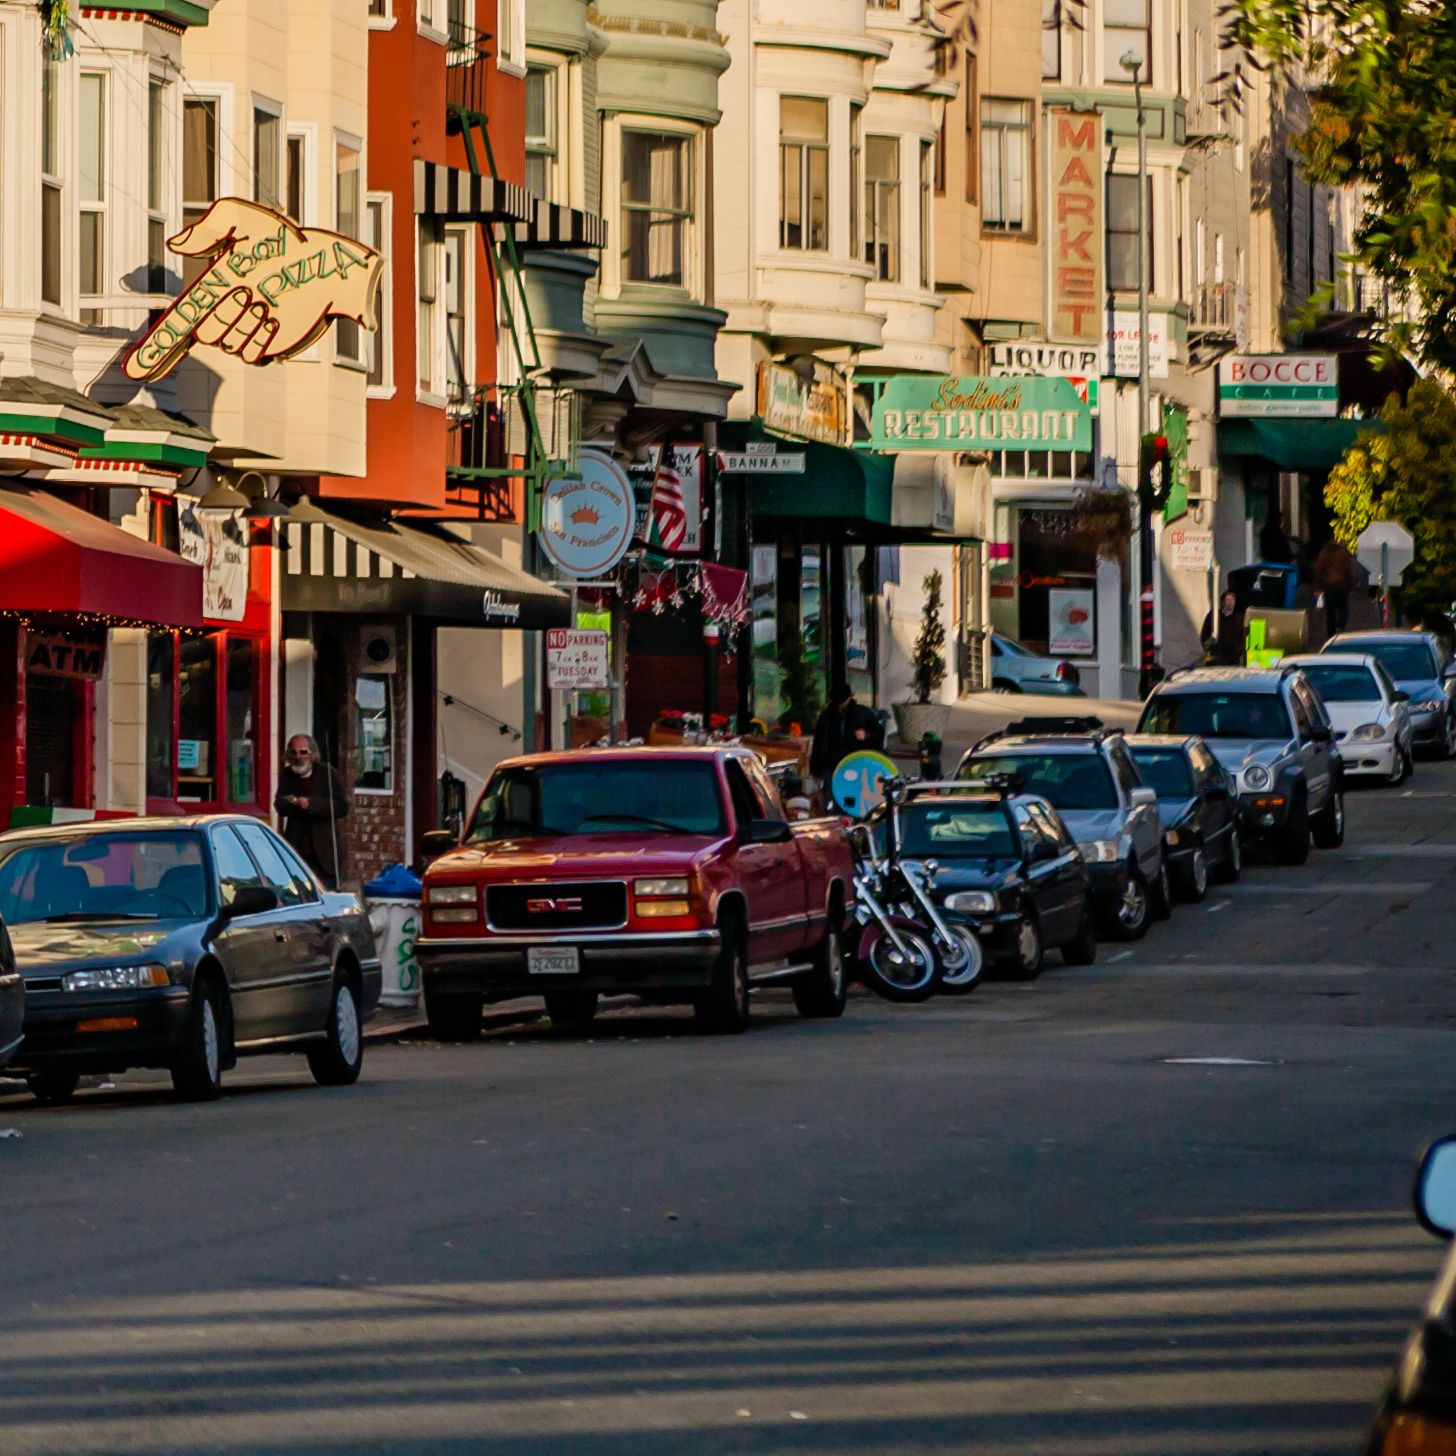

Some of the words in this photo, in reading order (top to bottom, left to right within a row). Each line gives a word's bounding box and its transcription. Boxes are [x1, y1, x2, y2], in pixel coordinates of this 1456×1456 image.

[1056, 117, 1096, 338] MARKET
[257, 241, 369, 307] PIZZA
[138, 268, 230, 369] GOLDEN
[226, 224, 288, 277] BOY
[1128, 331, 1159, 342] LESE
[990, 346, 1097, 372] LIQUOR
[1231, 362, 1329, 382] BOCCE
[1234, 387, 1324, 399] CAFE
[883, 409, 1080, 441] RESTAURANT
[549, 631, 566, 648] NO
[568, 634, 605, 646] PARKING
[28, 646, 101, 673] ATM
[527, 897, 583, 913] GMC
